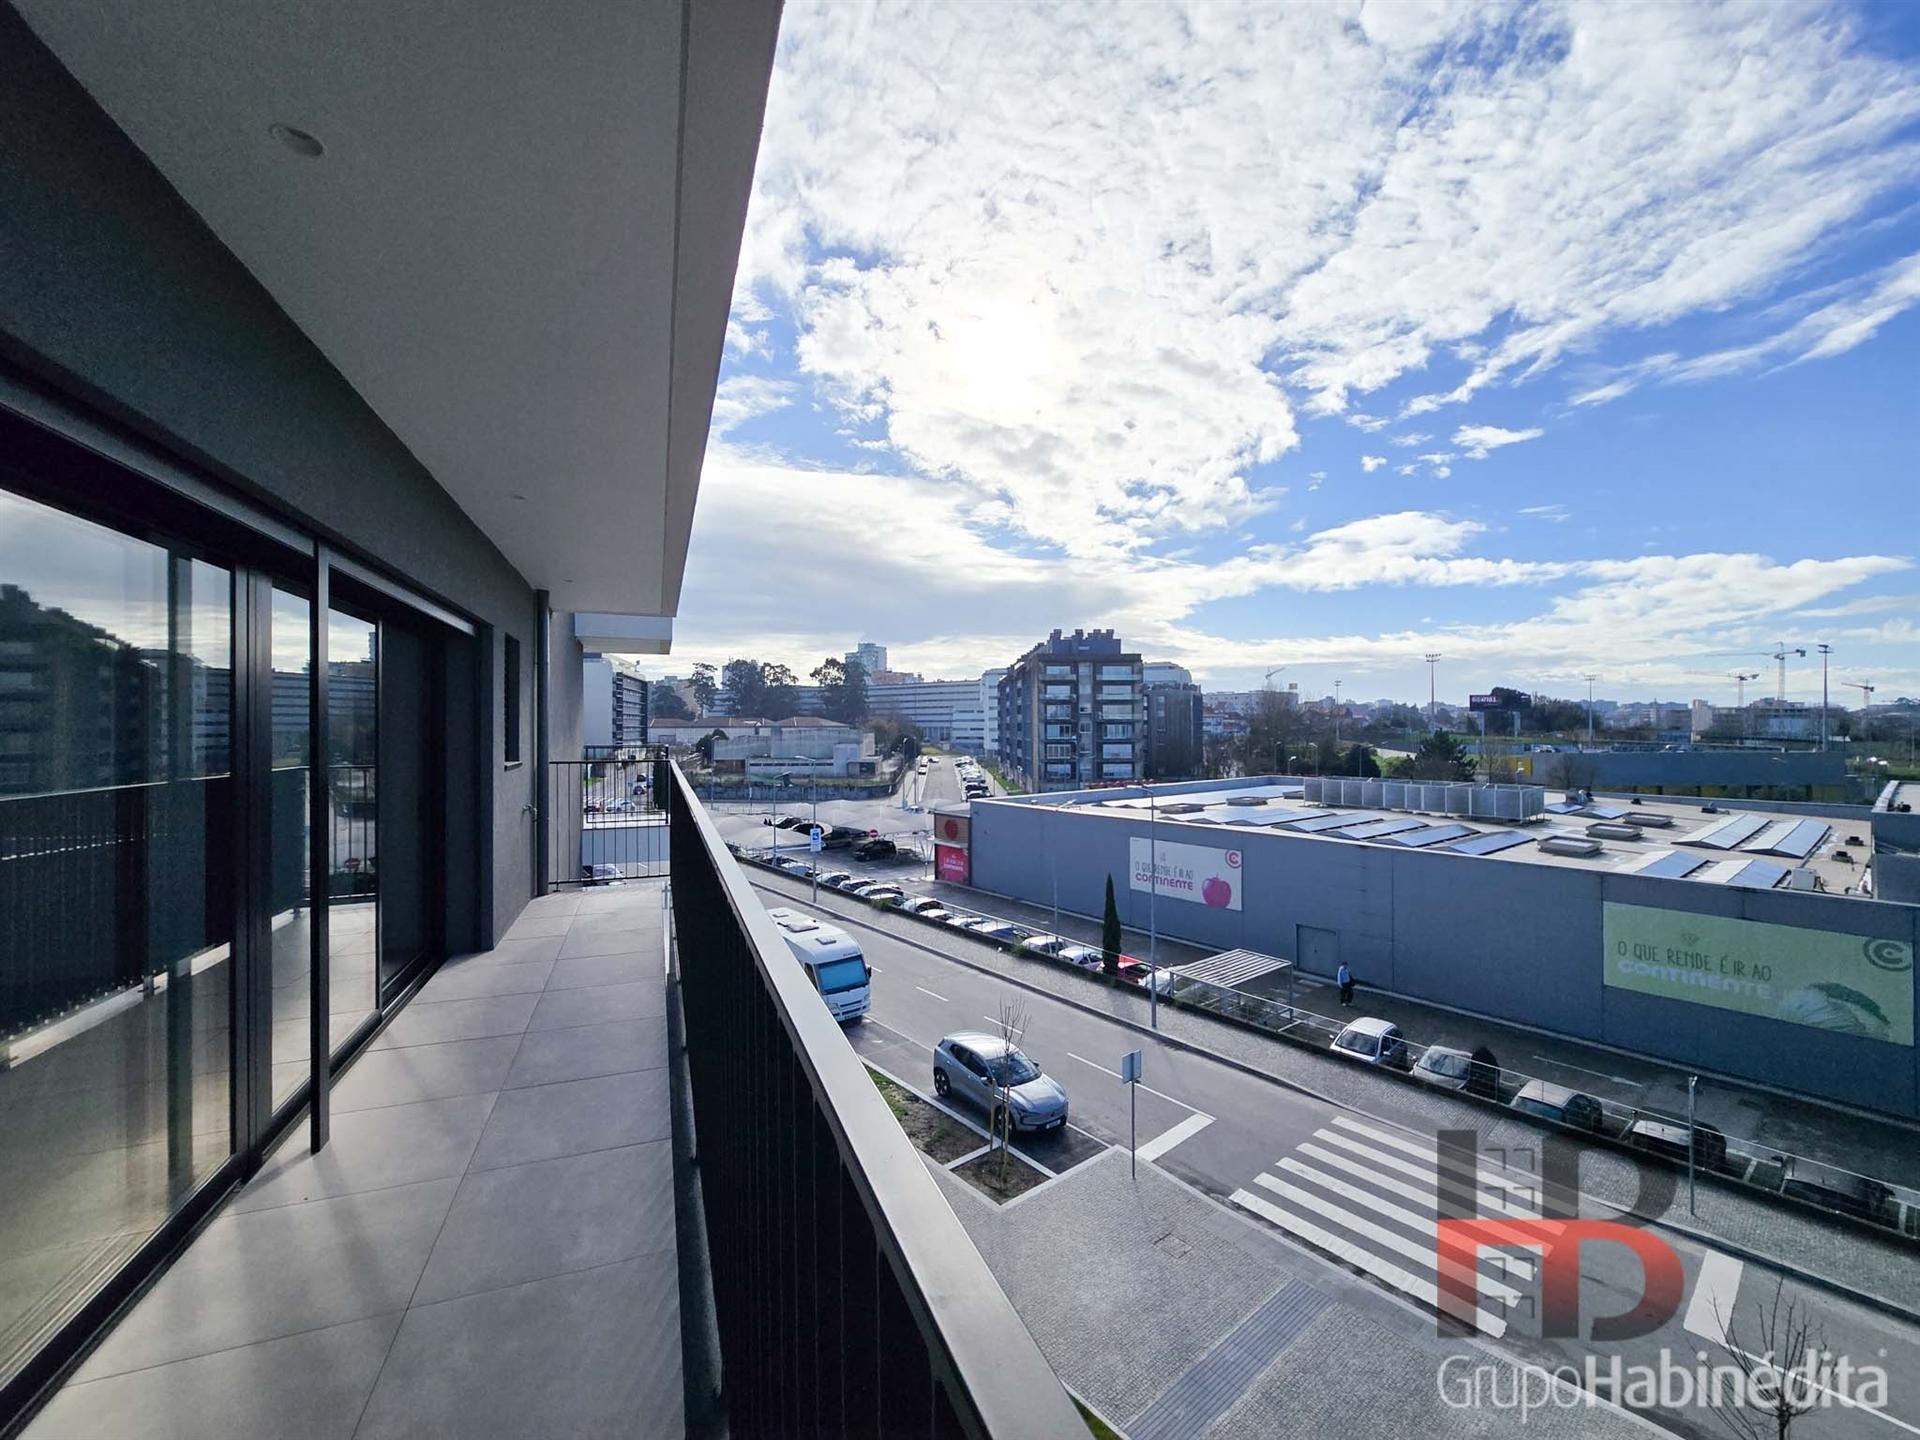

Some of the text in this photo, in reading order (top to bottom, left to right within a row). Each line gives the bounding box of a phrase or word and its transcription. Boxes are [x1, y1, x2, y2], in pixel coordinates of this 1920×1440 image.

[1617, 941, 1772, 981] O QUE RENDE É IR AO
[1617, 959, 1774, 999] CONTINENTE
